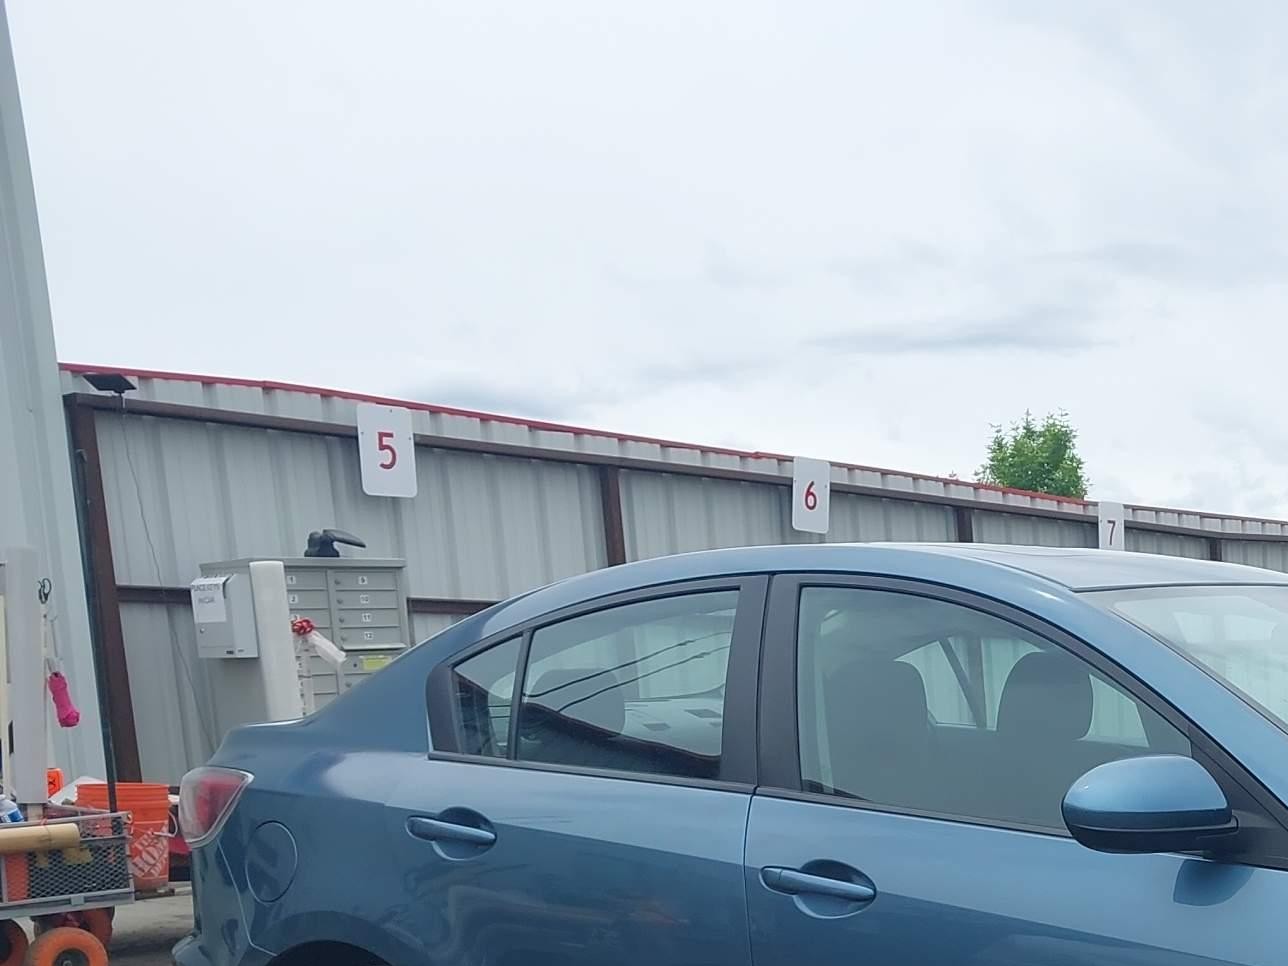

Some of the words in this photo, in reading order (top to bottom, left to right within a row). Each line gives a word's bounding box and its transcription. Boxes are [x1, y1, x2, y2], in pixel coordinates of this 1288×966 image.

[377, 431, 397, 470] 5
[803, 480, 817, 511] 6
[1107, 519, 1116, 546] 7
